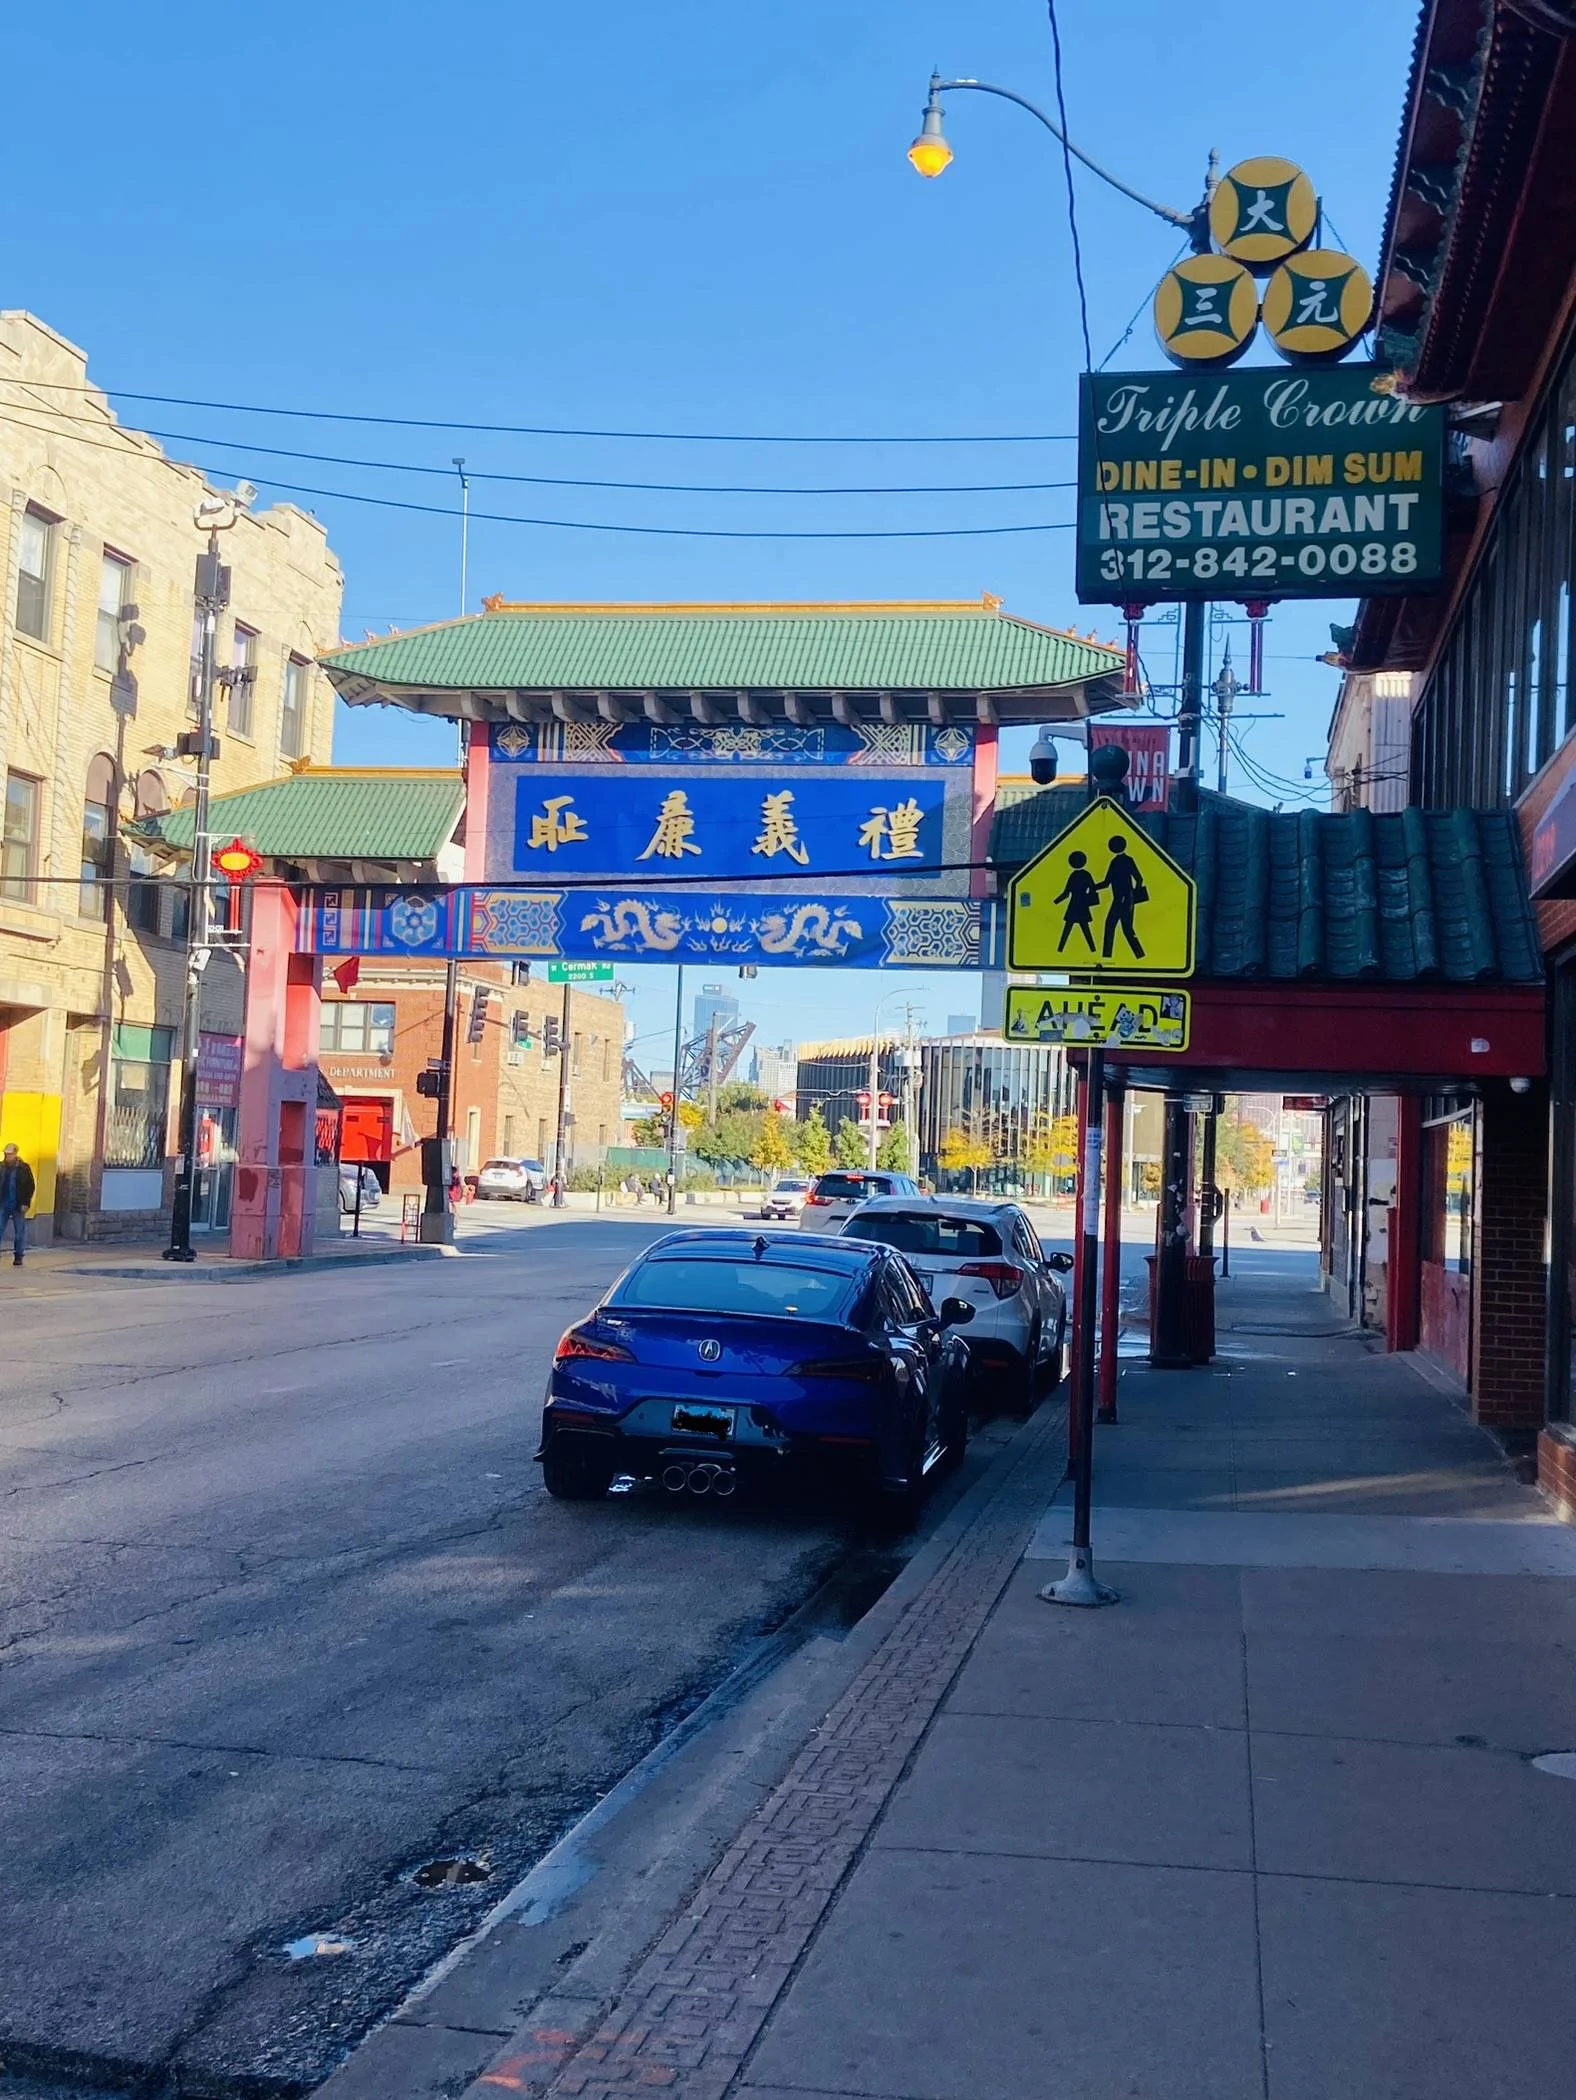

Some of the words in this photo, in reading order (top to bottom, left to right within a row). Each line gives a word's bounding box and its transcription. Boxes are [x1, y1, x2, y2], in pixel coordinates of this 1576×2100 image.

[1240, 190, 1284, 231] 大
[1184, 287, 1223, 326] 三
[1297, 281, 1338, 324] 元
[1097, 385, 1241, 452] Triple
[1264, 379, 1427, 428] Crown
[1096, 458, 1236, 491] DINE-IN
[1266, 455, 1334, 488] DIM
[1343, 451, 1423, 484] SUM
[1100, 493, 1419, 540] RESTAURANT
[1100, 542, 1418, 581] 312-842-0088
[329, 1066, 395, 1079] DEPARTMENT
